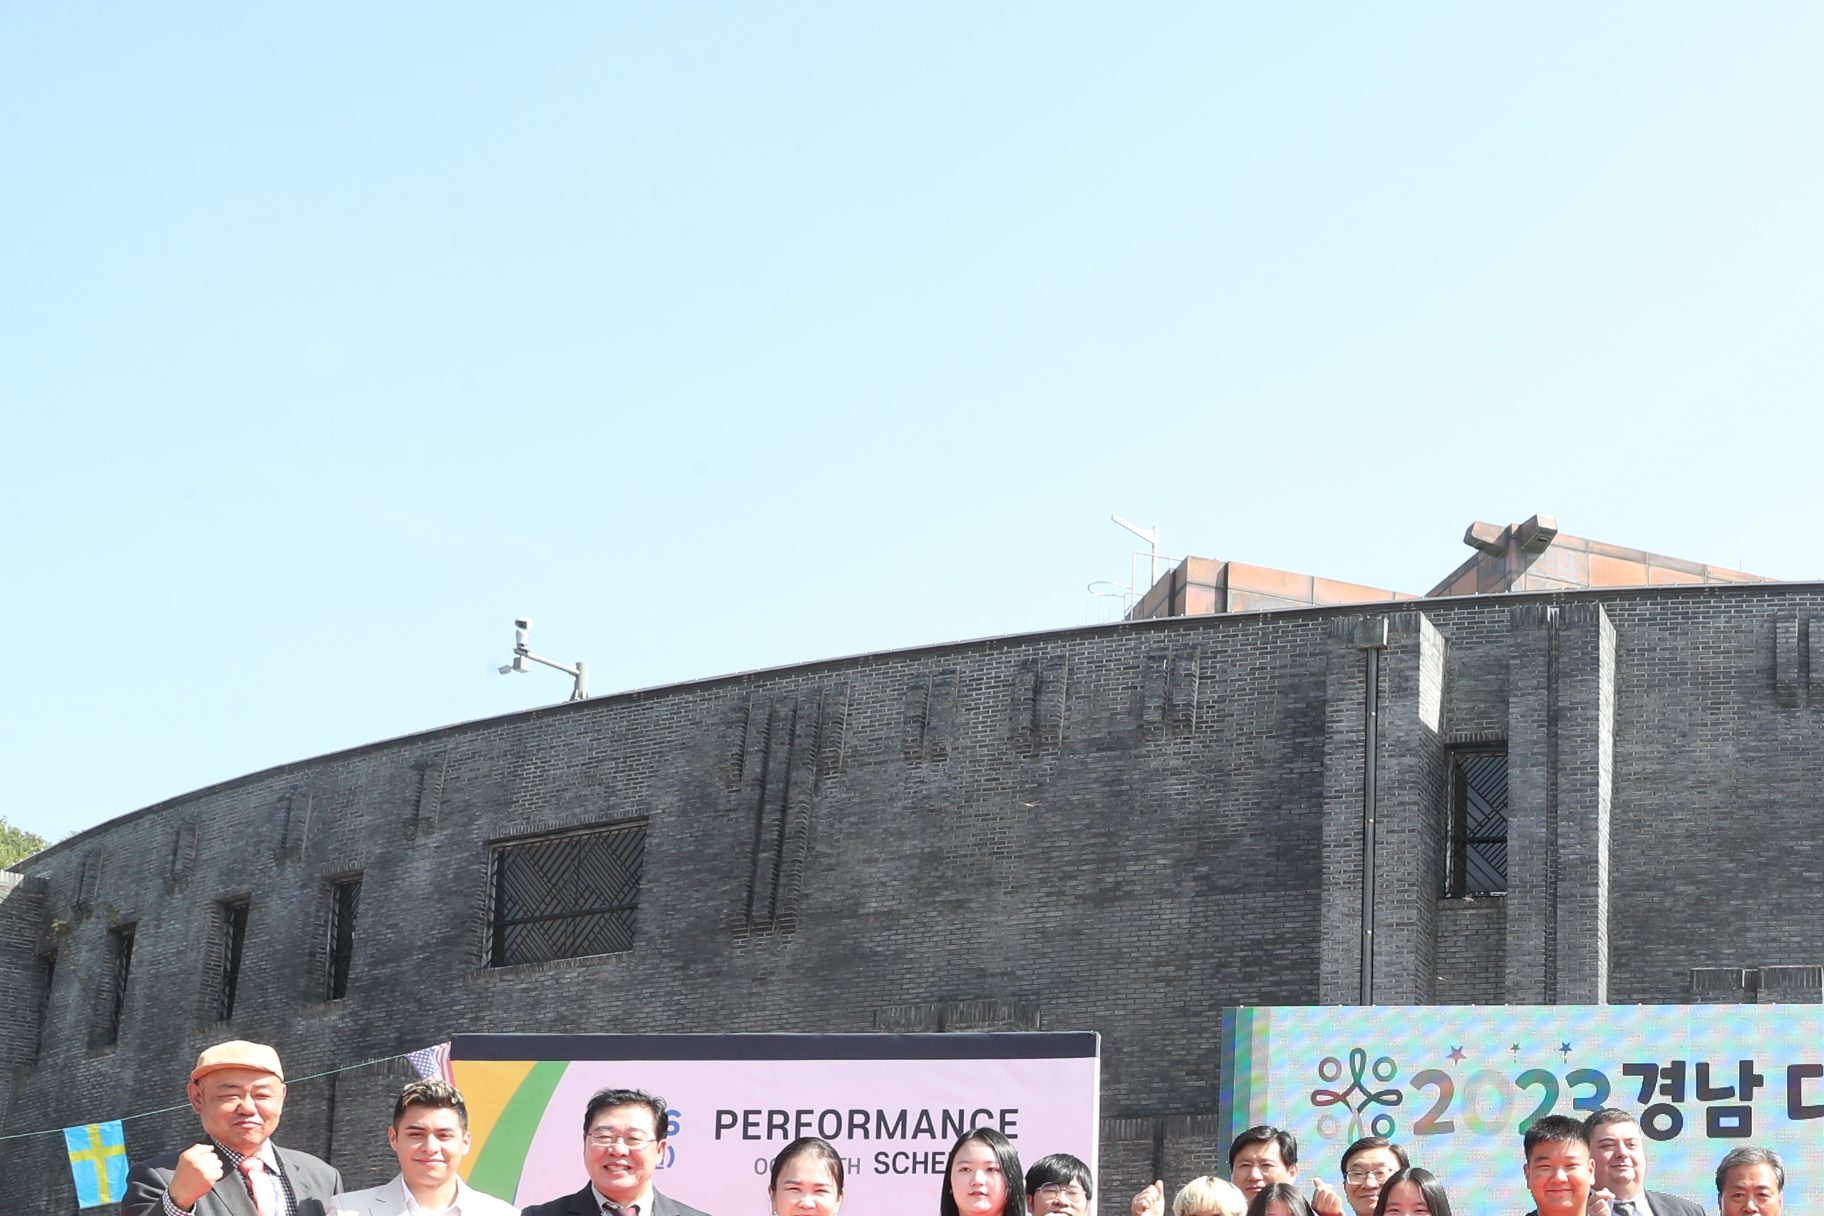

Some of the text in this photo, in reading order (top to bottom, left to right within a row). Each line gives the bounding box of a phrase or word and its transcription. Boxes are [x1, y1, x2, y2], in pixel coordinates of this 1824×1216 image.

[714, 1108, 1020, 1141] PERFORMANCE
[1410, 1068, 1611, 1136] 2023
[1622, 1059, 1765, 1142] 경남
